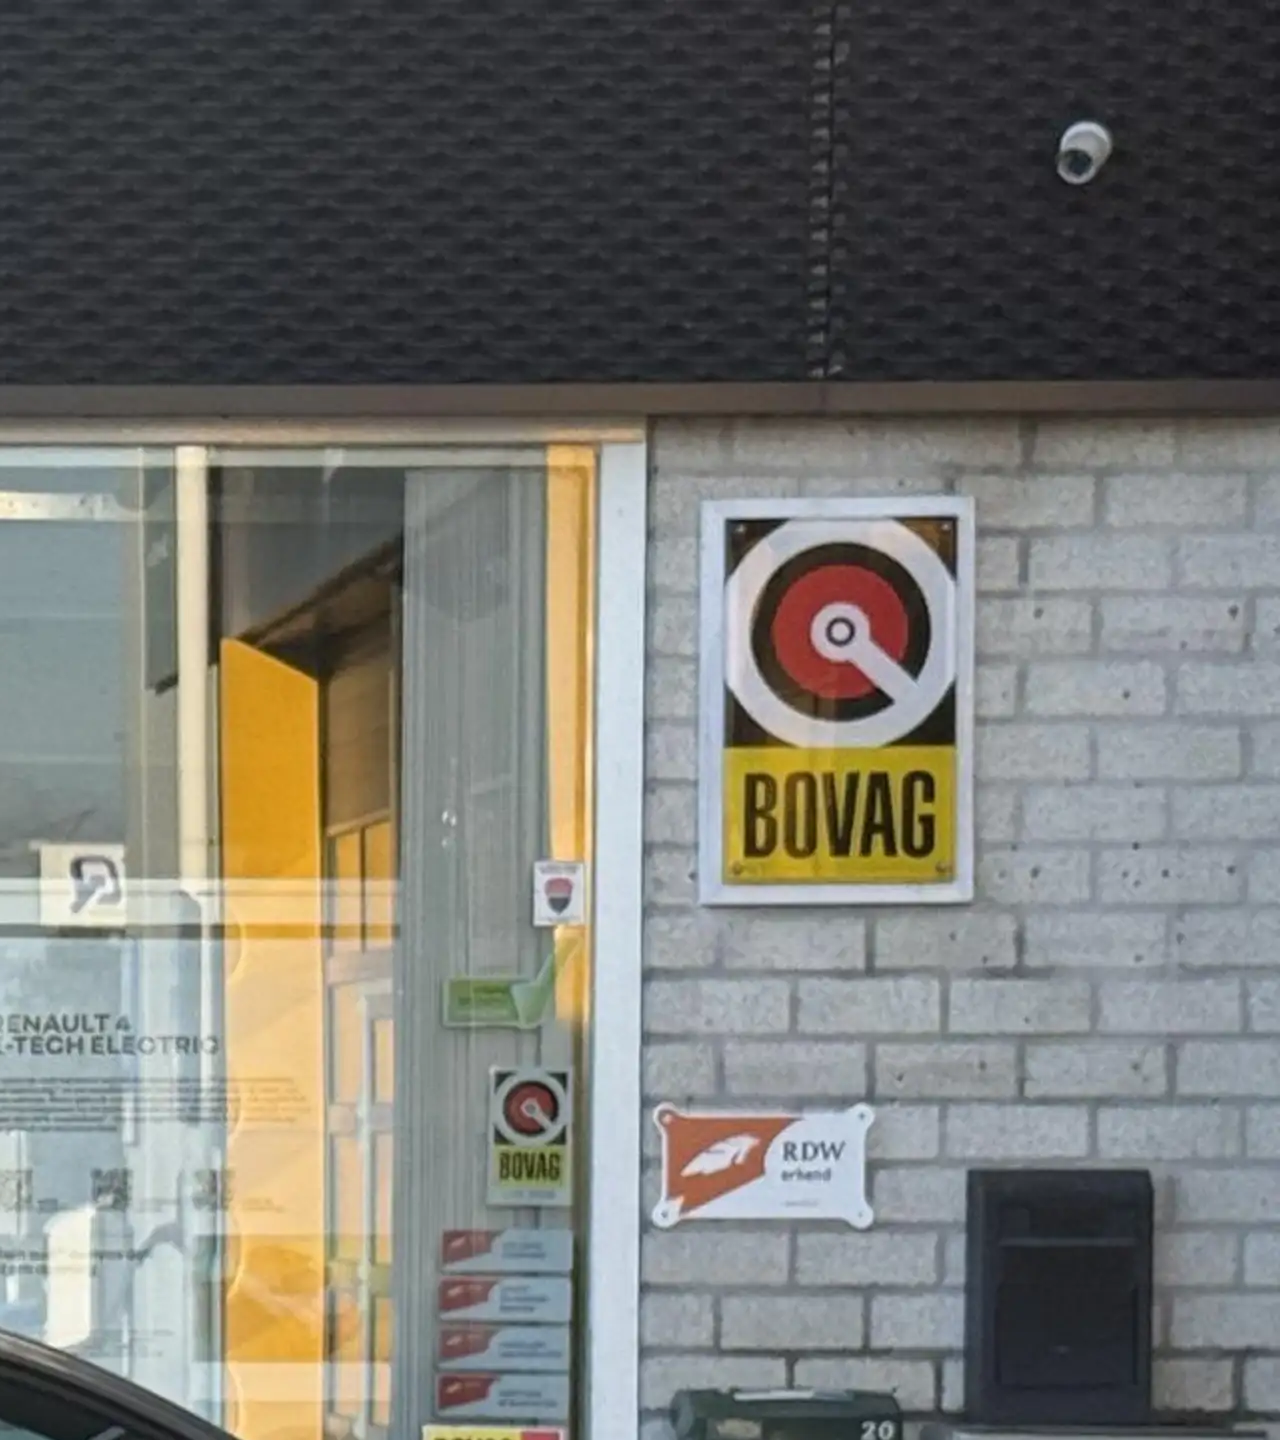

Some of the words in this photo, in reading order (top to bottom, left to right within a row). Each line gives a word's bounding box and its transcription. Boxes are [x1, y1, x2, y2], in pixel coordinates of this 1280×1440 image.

[744, 769, 936, 859] BOVAG
[92, 1035, 220, 1056] ELECTRIC
[783, 1140, 846, 1162] RDW
[500, 1151, 561, 1182] BOVAG
[781, 1167, 832, 1182] erkend
